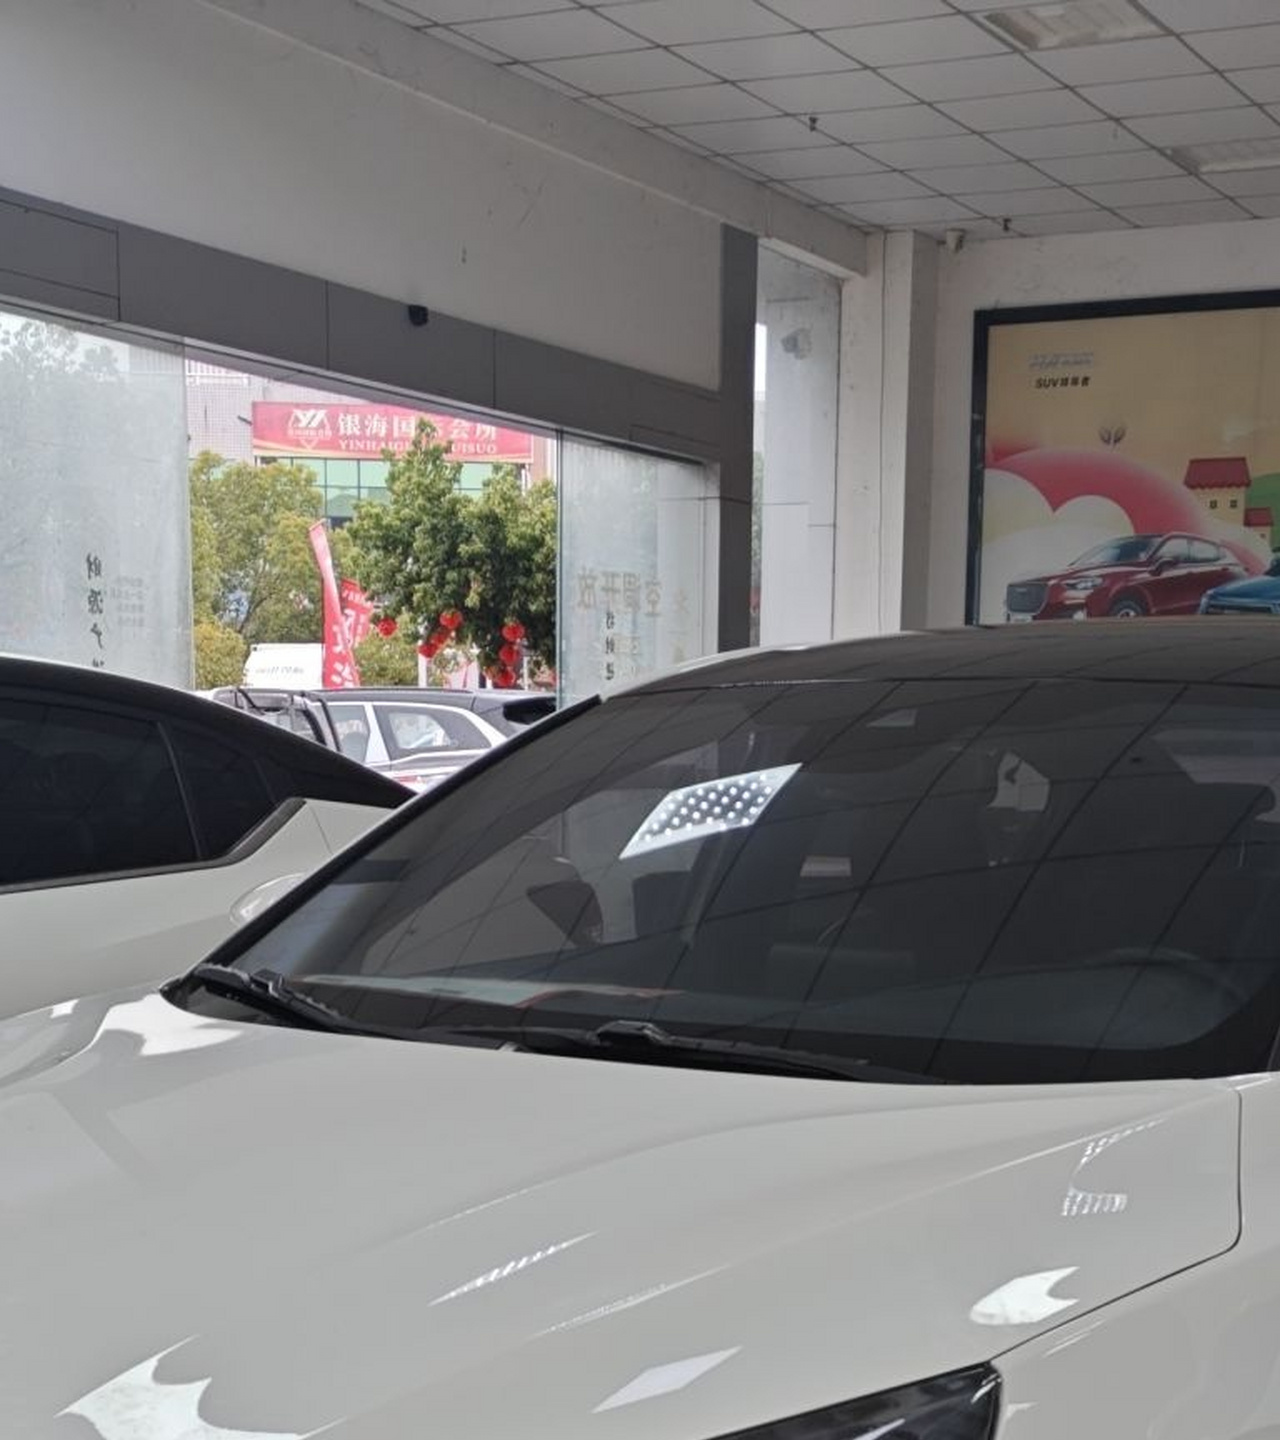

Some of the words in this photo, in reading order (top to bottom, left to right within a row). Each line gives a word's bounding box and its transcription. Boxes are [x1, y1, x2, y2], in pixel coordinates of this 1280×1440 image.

[339, 411, 497, 440] 银海国会所
